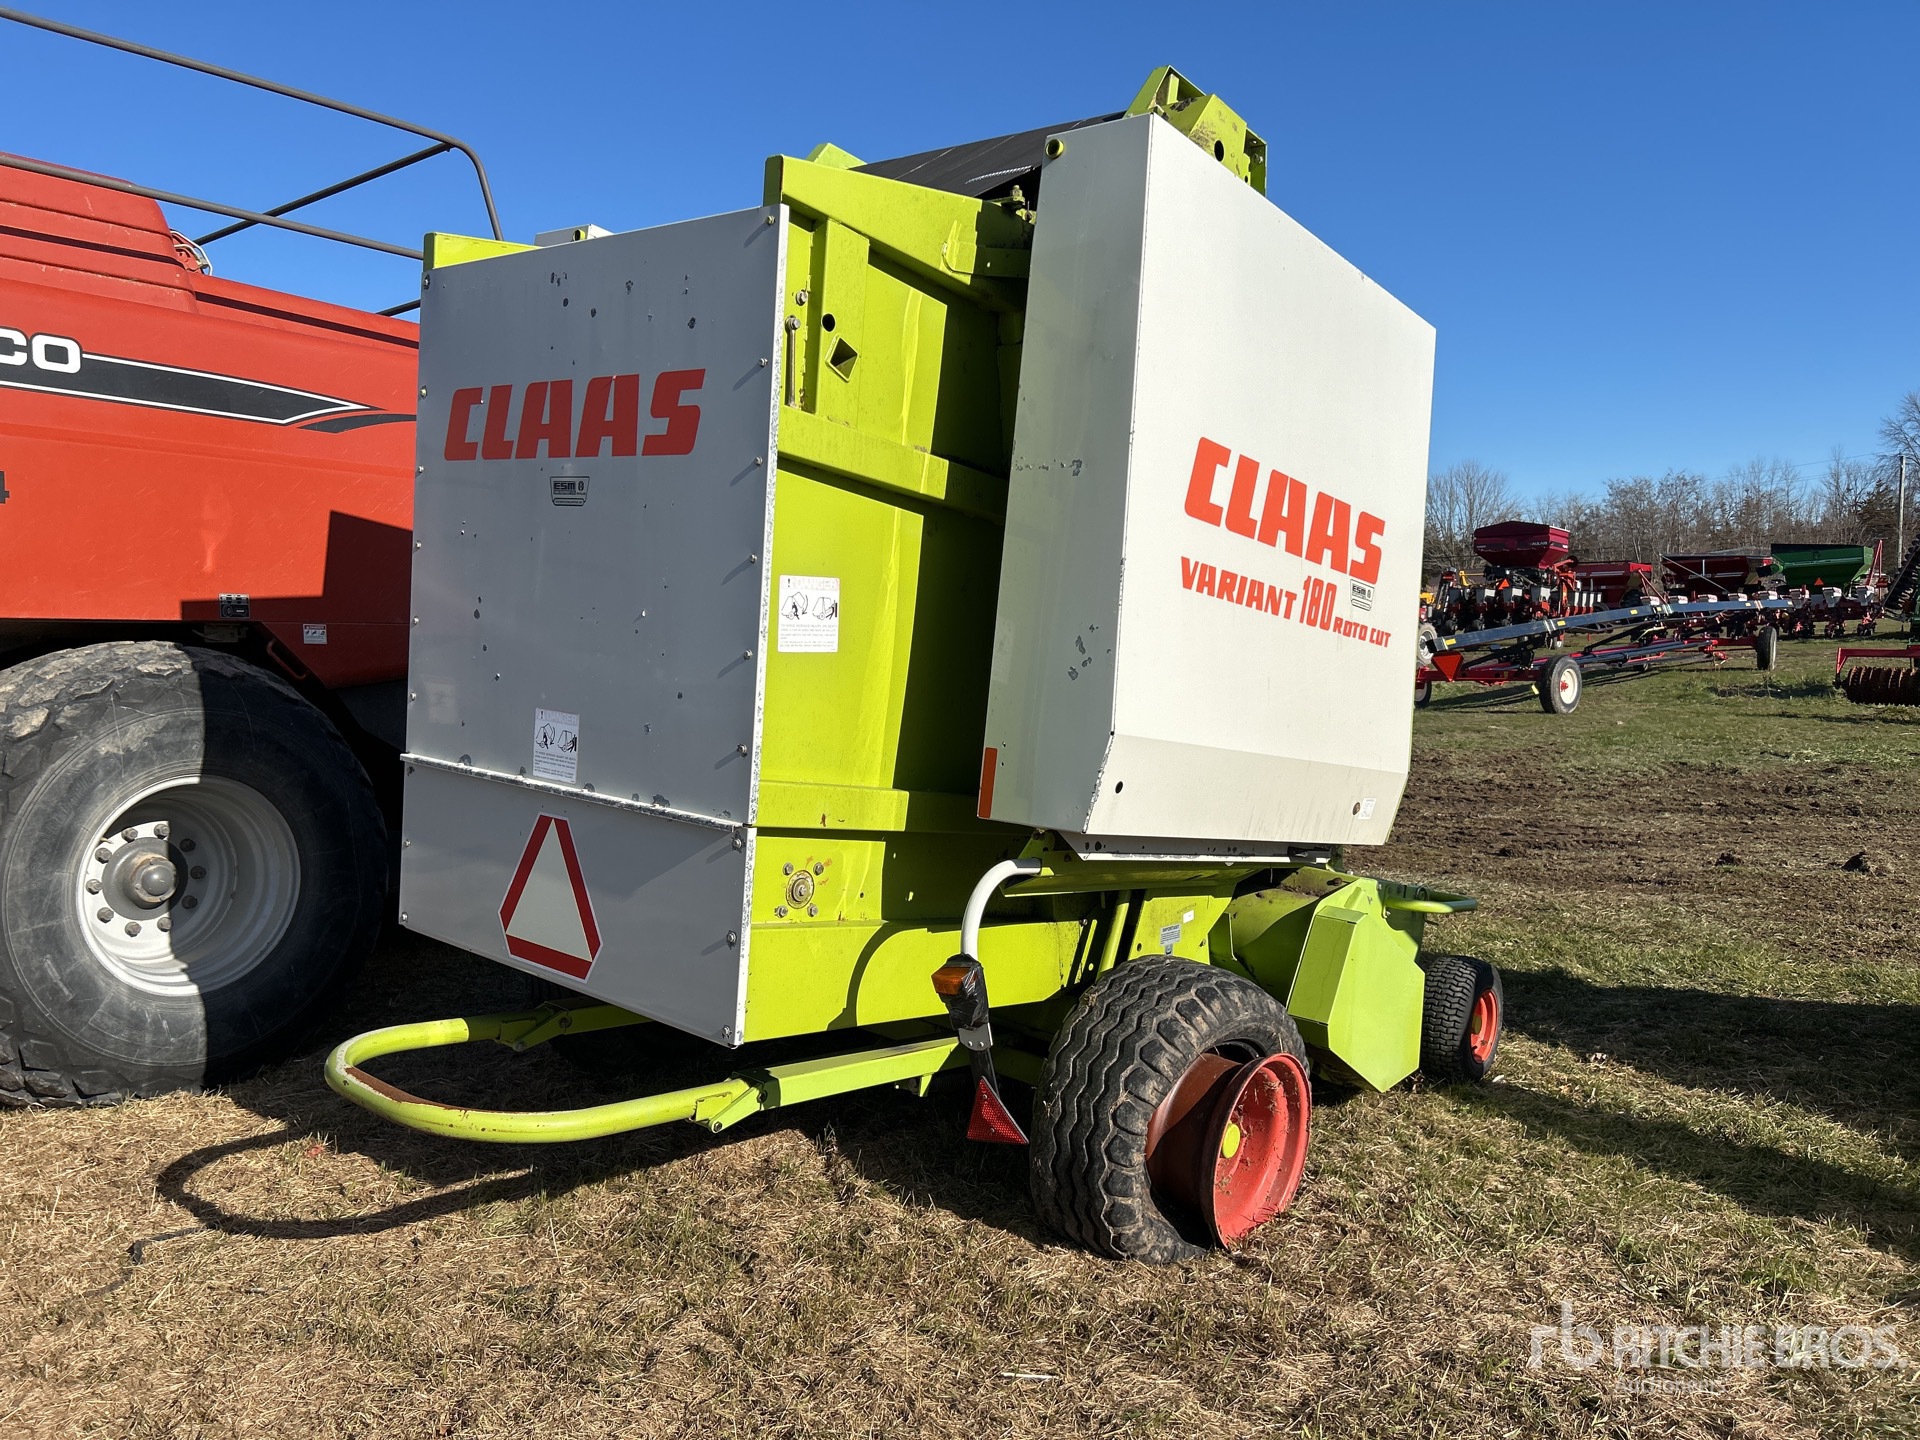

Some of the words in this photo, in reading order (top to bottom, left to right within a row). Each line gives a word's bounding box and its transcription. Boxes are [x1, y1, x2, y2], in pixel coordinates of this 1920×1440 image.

[444, 368, 706, 461] CLAAS
[553, 482, 576, 490] ESM
[1184, 436, 1386, 585] CLAAS
[1181, 556, 1298, 620] VARIANT
[1299, 575, 1337, 631] 180
[1332, 616, 1368, 642] ROTO
[1369, 628, 1391, 648] CUT
